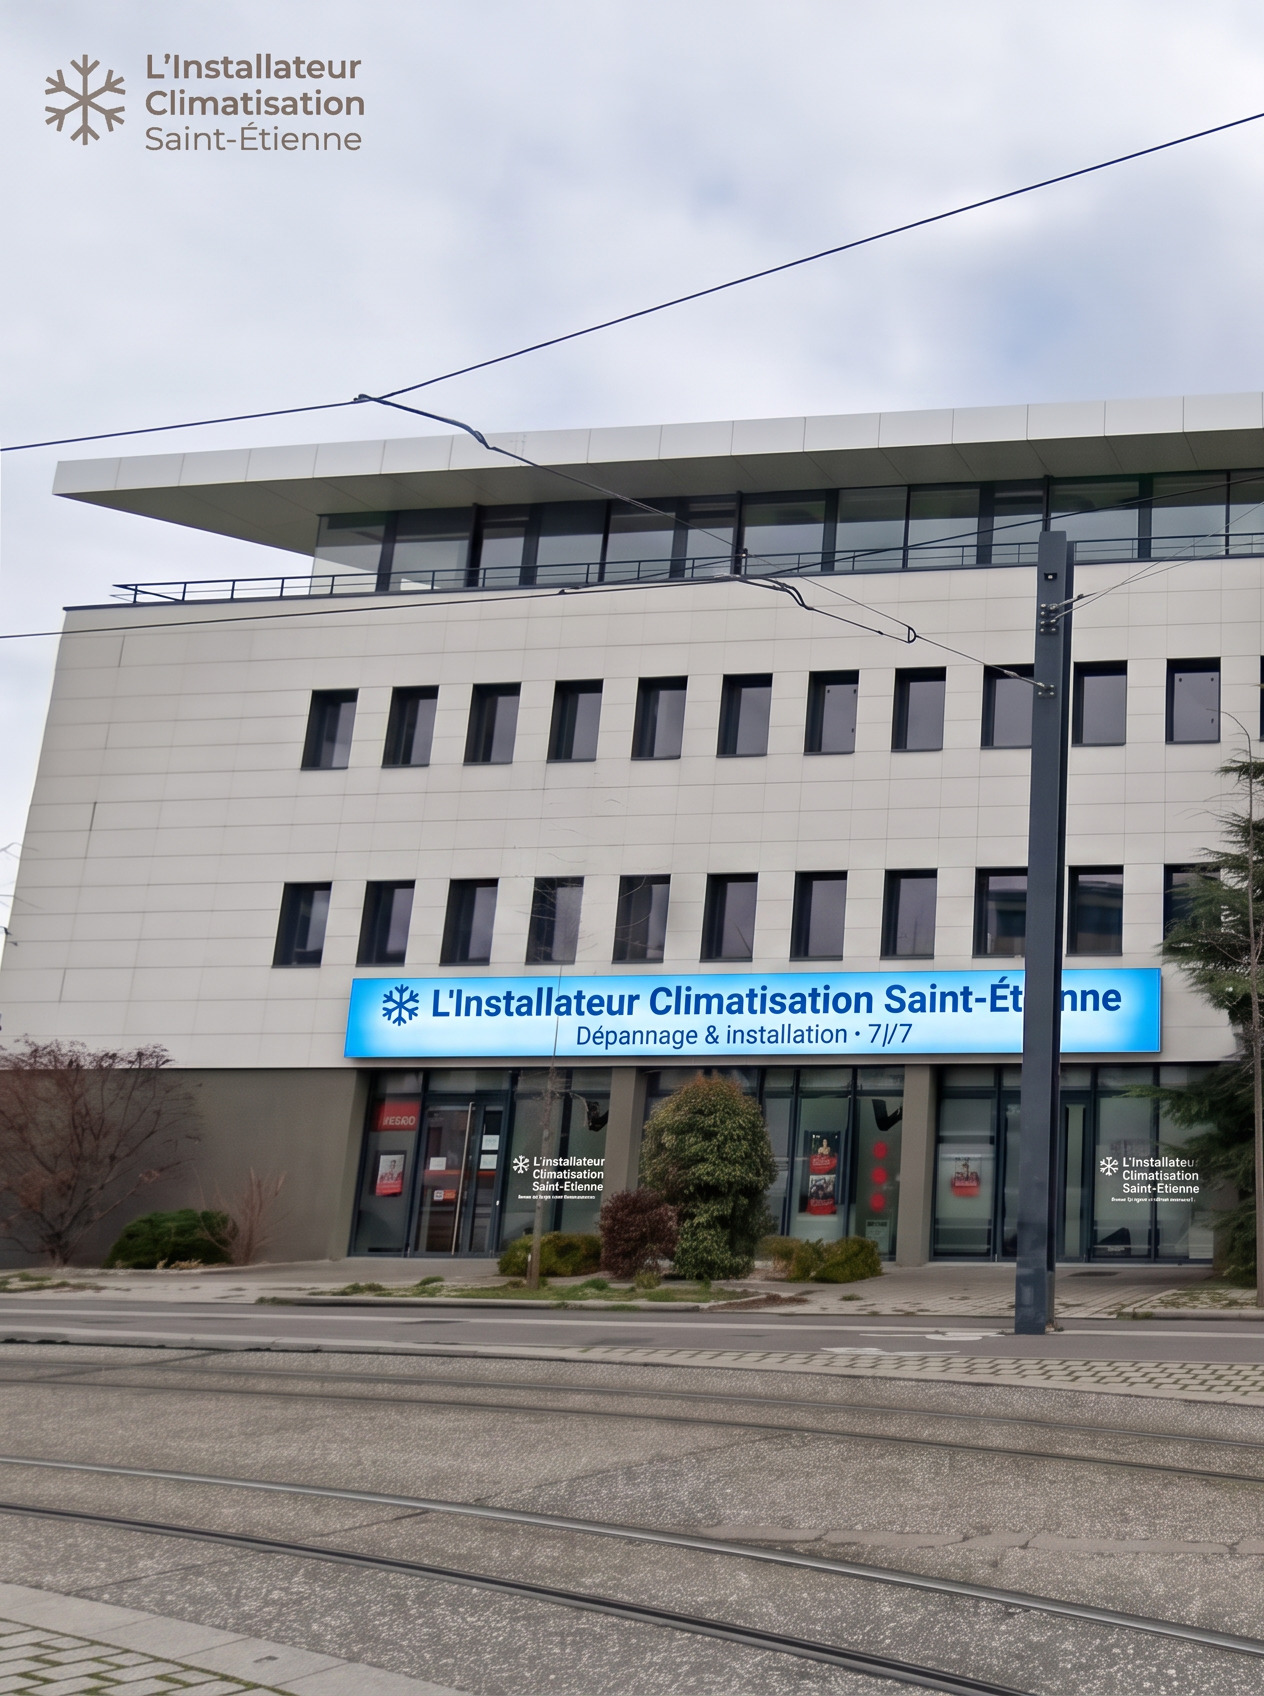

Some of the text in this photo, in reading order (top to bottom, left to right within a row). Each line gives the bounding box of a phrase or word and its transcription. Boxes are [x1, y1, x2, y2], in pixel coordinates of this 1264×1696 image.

[432, 976, 1122, 1018] L'Installateur Climatisation Saint-Étnne
[576, 1024, 698, 1050] Dépannage
[704, 1025, 720, 1045] &
[726, 1023, 848, 1045] installation
[532, 1169, 604, 1180] Climatisation
[1122, 1170, 1199, 1181] Climatisation
